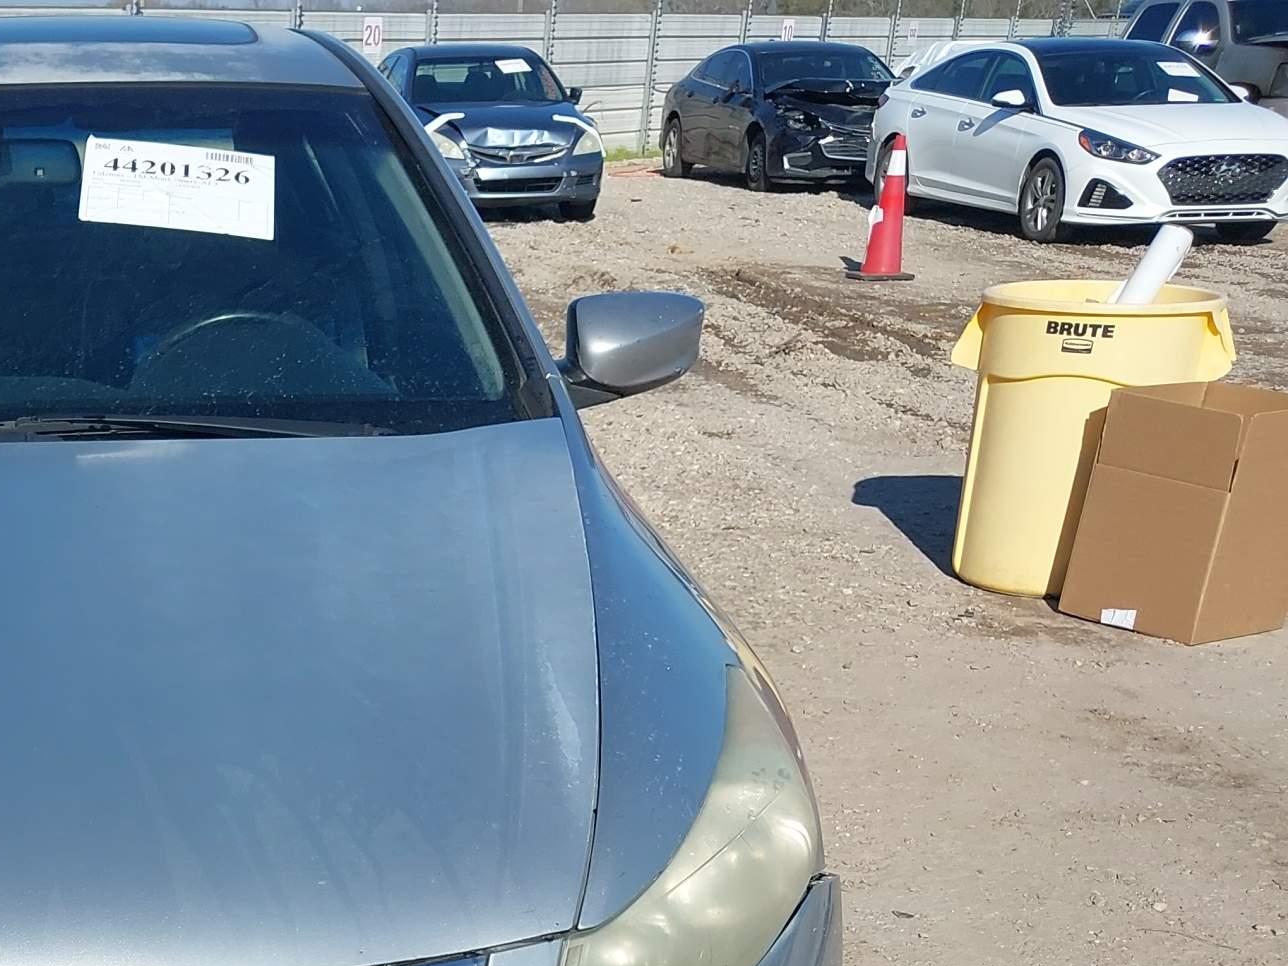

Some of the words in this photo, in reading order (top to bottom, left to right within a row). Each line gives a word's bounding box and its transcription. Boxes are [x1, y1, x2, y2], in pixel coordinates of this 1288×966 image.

[365, 24, 381, 46] 20
[784, 24, 793, 42] 10
[103, 157, 251, 185] 44201326
[1046, 320, 1115, 338] BRUTE
